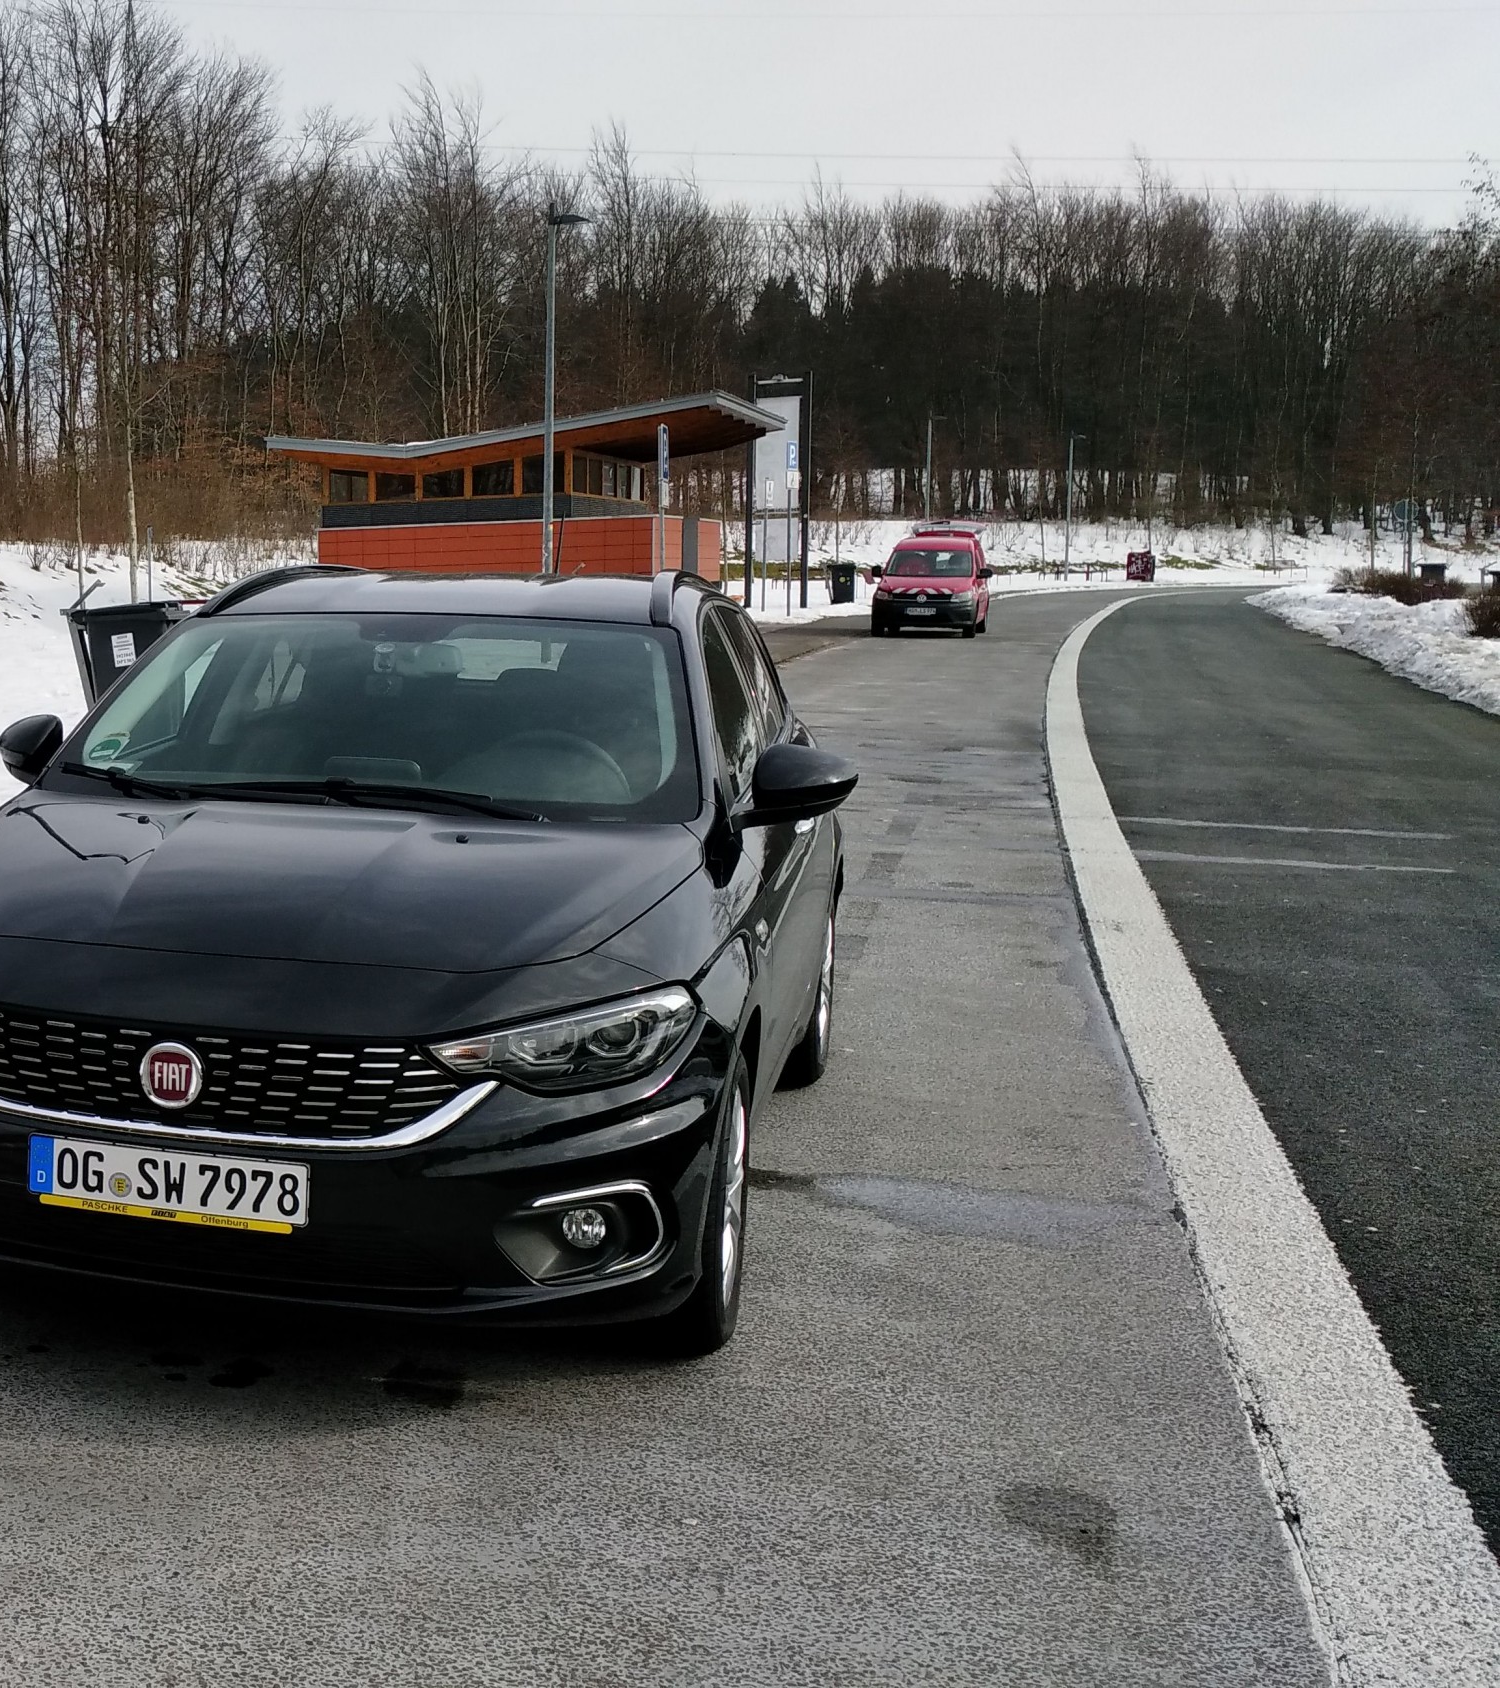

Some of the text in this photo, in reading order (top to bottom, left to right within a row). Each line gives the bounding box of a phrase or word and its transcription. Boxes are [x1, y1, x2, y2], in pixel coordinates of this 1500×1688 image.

[153, 1060, 190, 1092] FIAT
[36, 1170, 47, 1183] D
[57, 1147, 300, 1217] OG SW 7978
[81, 1200, 129, 1214] PASCHKE
[200, 1215, 249, 1230] Offenburg
